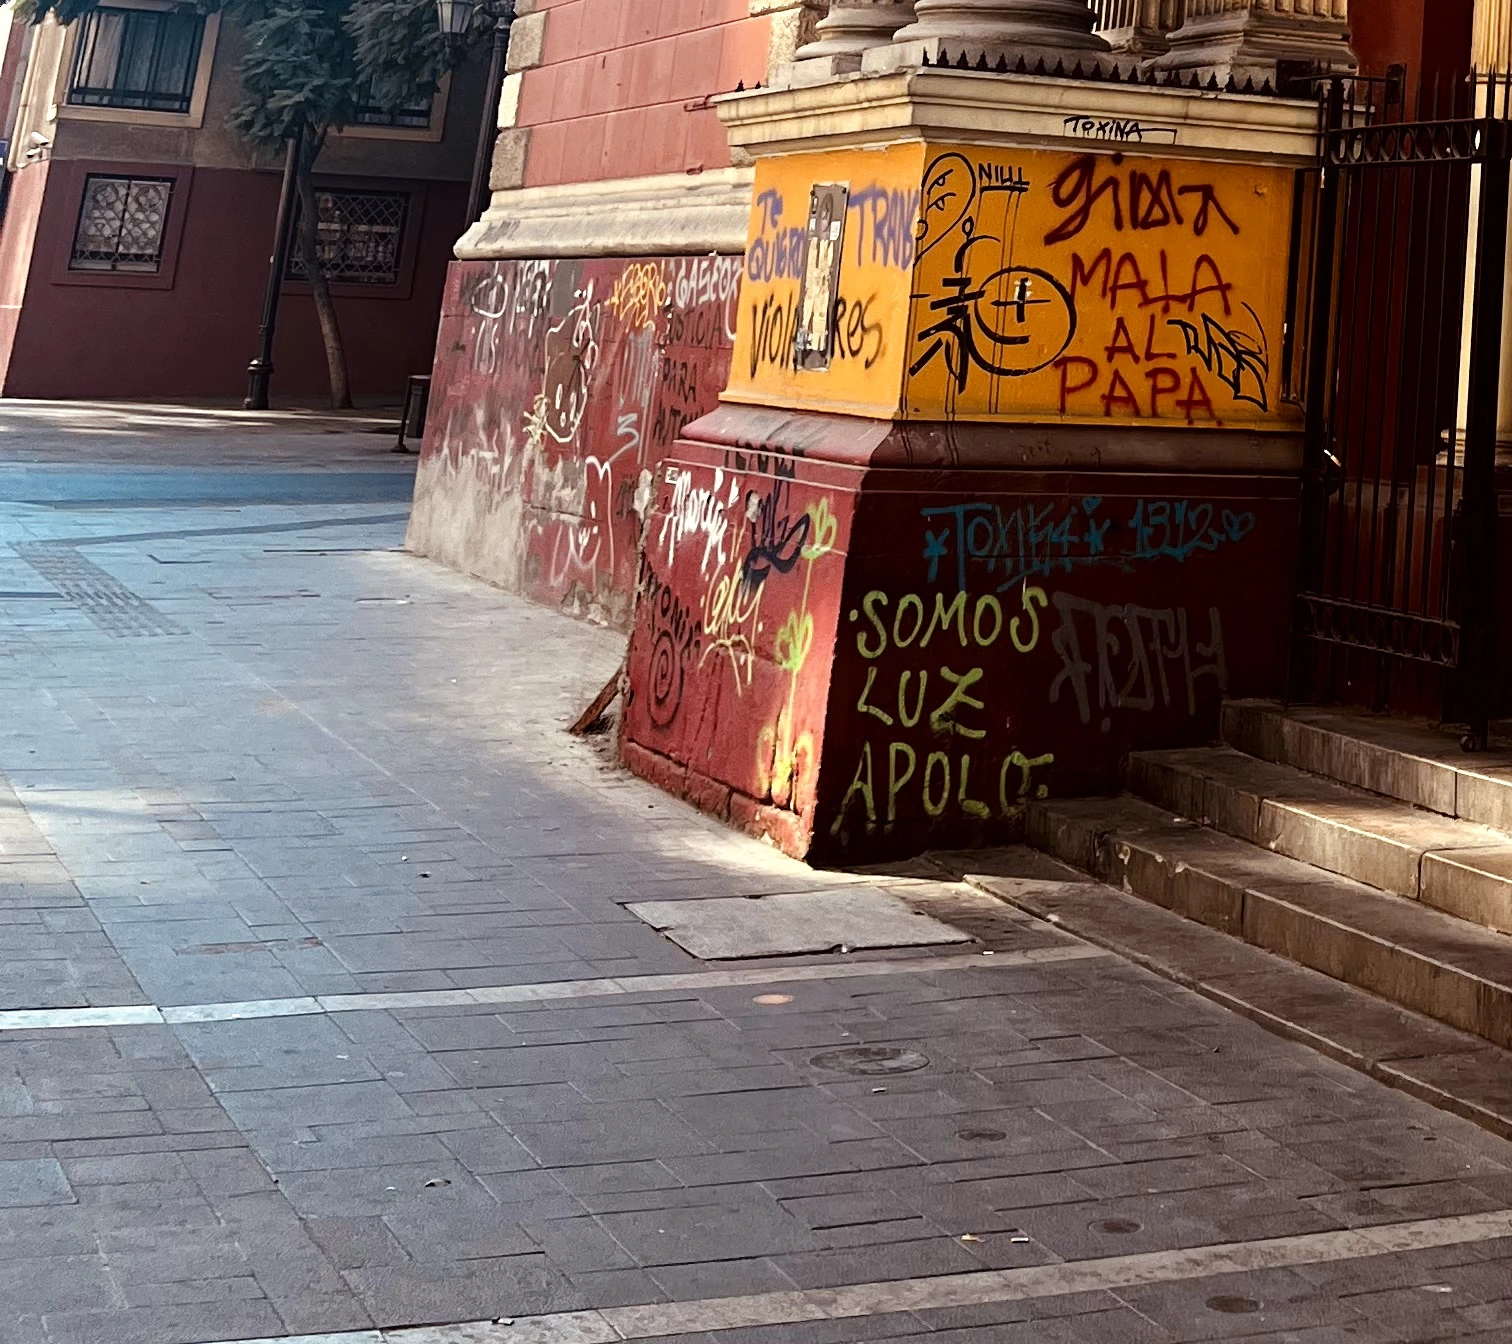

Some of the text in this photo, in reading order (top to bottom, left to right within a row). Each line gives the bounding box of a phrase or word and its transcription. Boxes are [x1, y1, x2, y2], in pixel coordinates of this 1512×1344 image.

[1069, 247, 1232, 316] MALA
[1104, 312, 1177, 365] AL
[1053, 355, 1223, 426] PAPA
[857, 586, 1048, 659] SOMOS
[857, 665, 986, 739] LUZ
